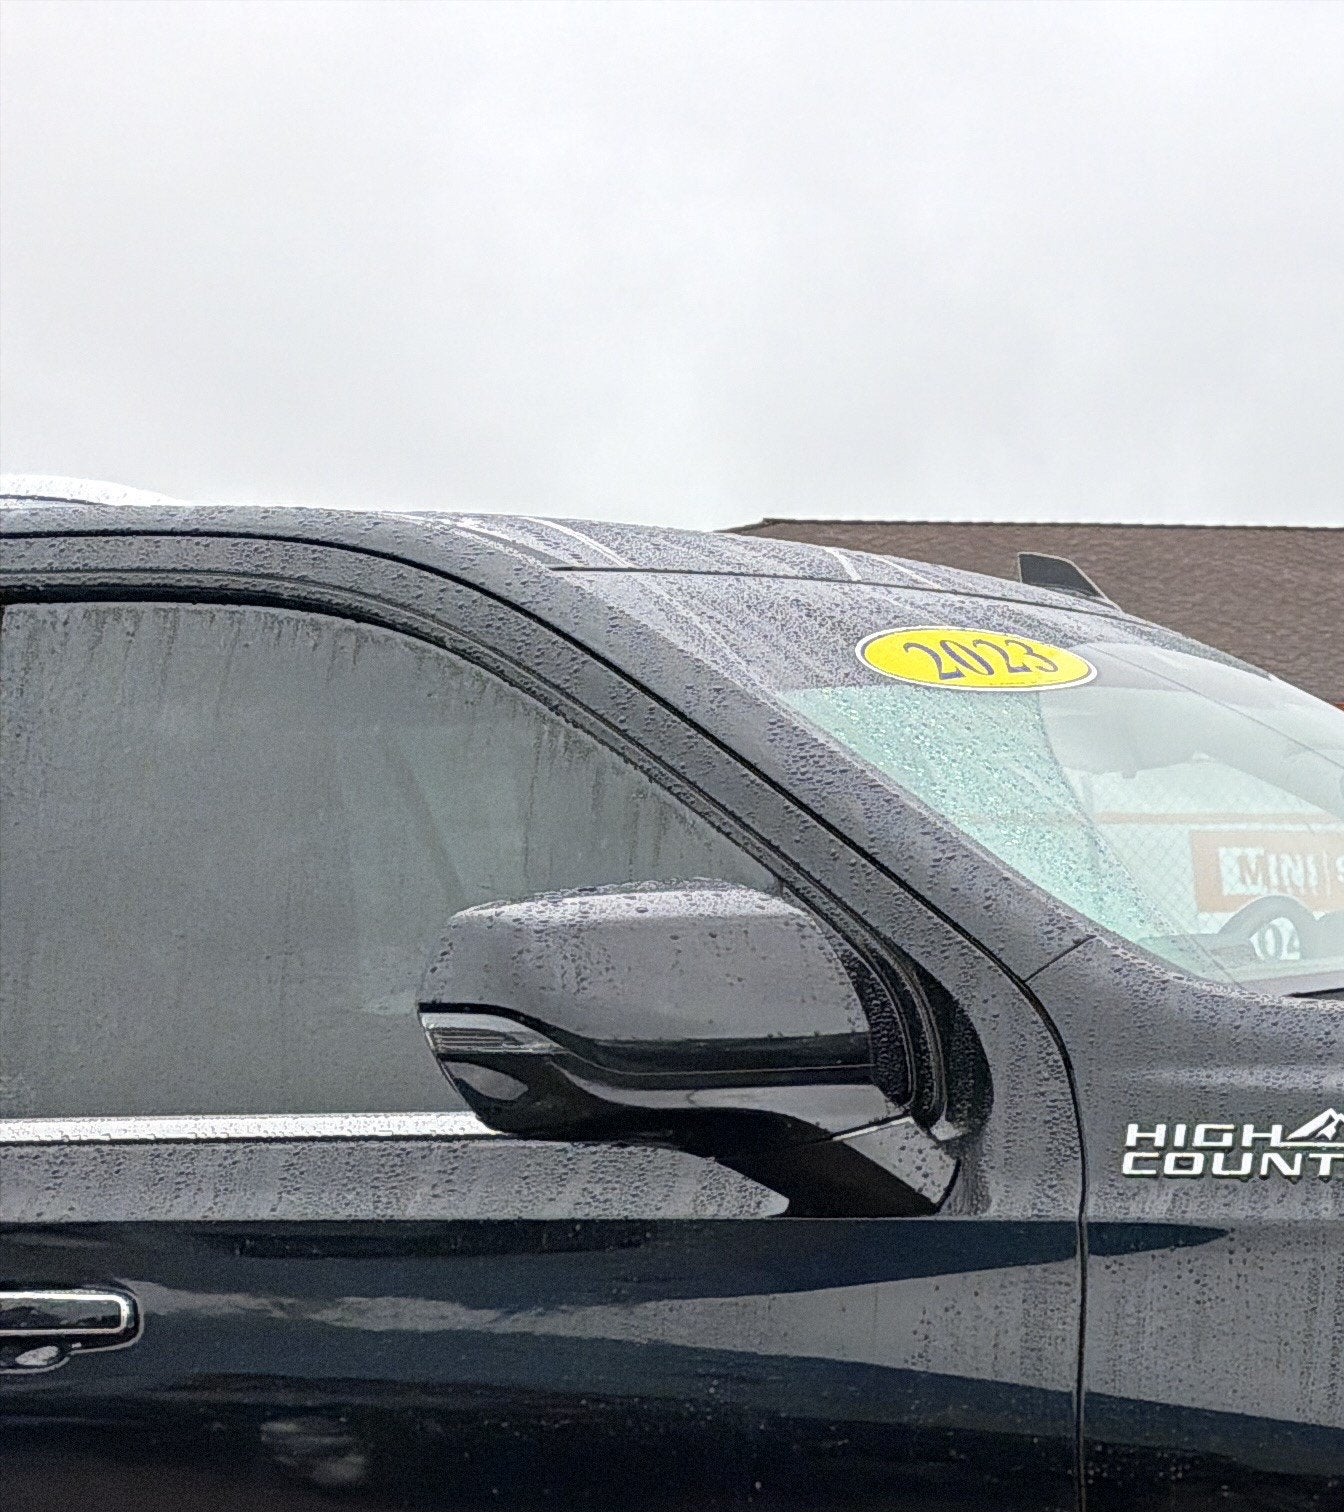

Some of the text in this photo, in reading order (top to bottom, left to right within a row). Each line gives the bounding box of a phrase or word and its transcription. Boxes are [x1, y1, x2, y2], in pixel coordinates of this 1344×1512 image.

[903, 639, 1059, 680] 2023
[1237, 852, 1319, 896] MINI
[1125, 1123, 1283, 1148] HIGH
